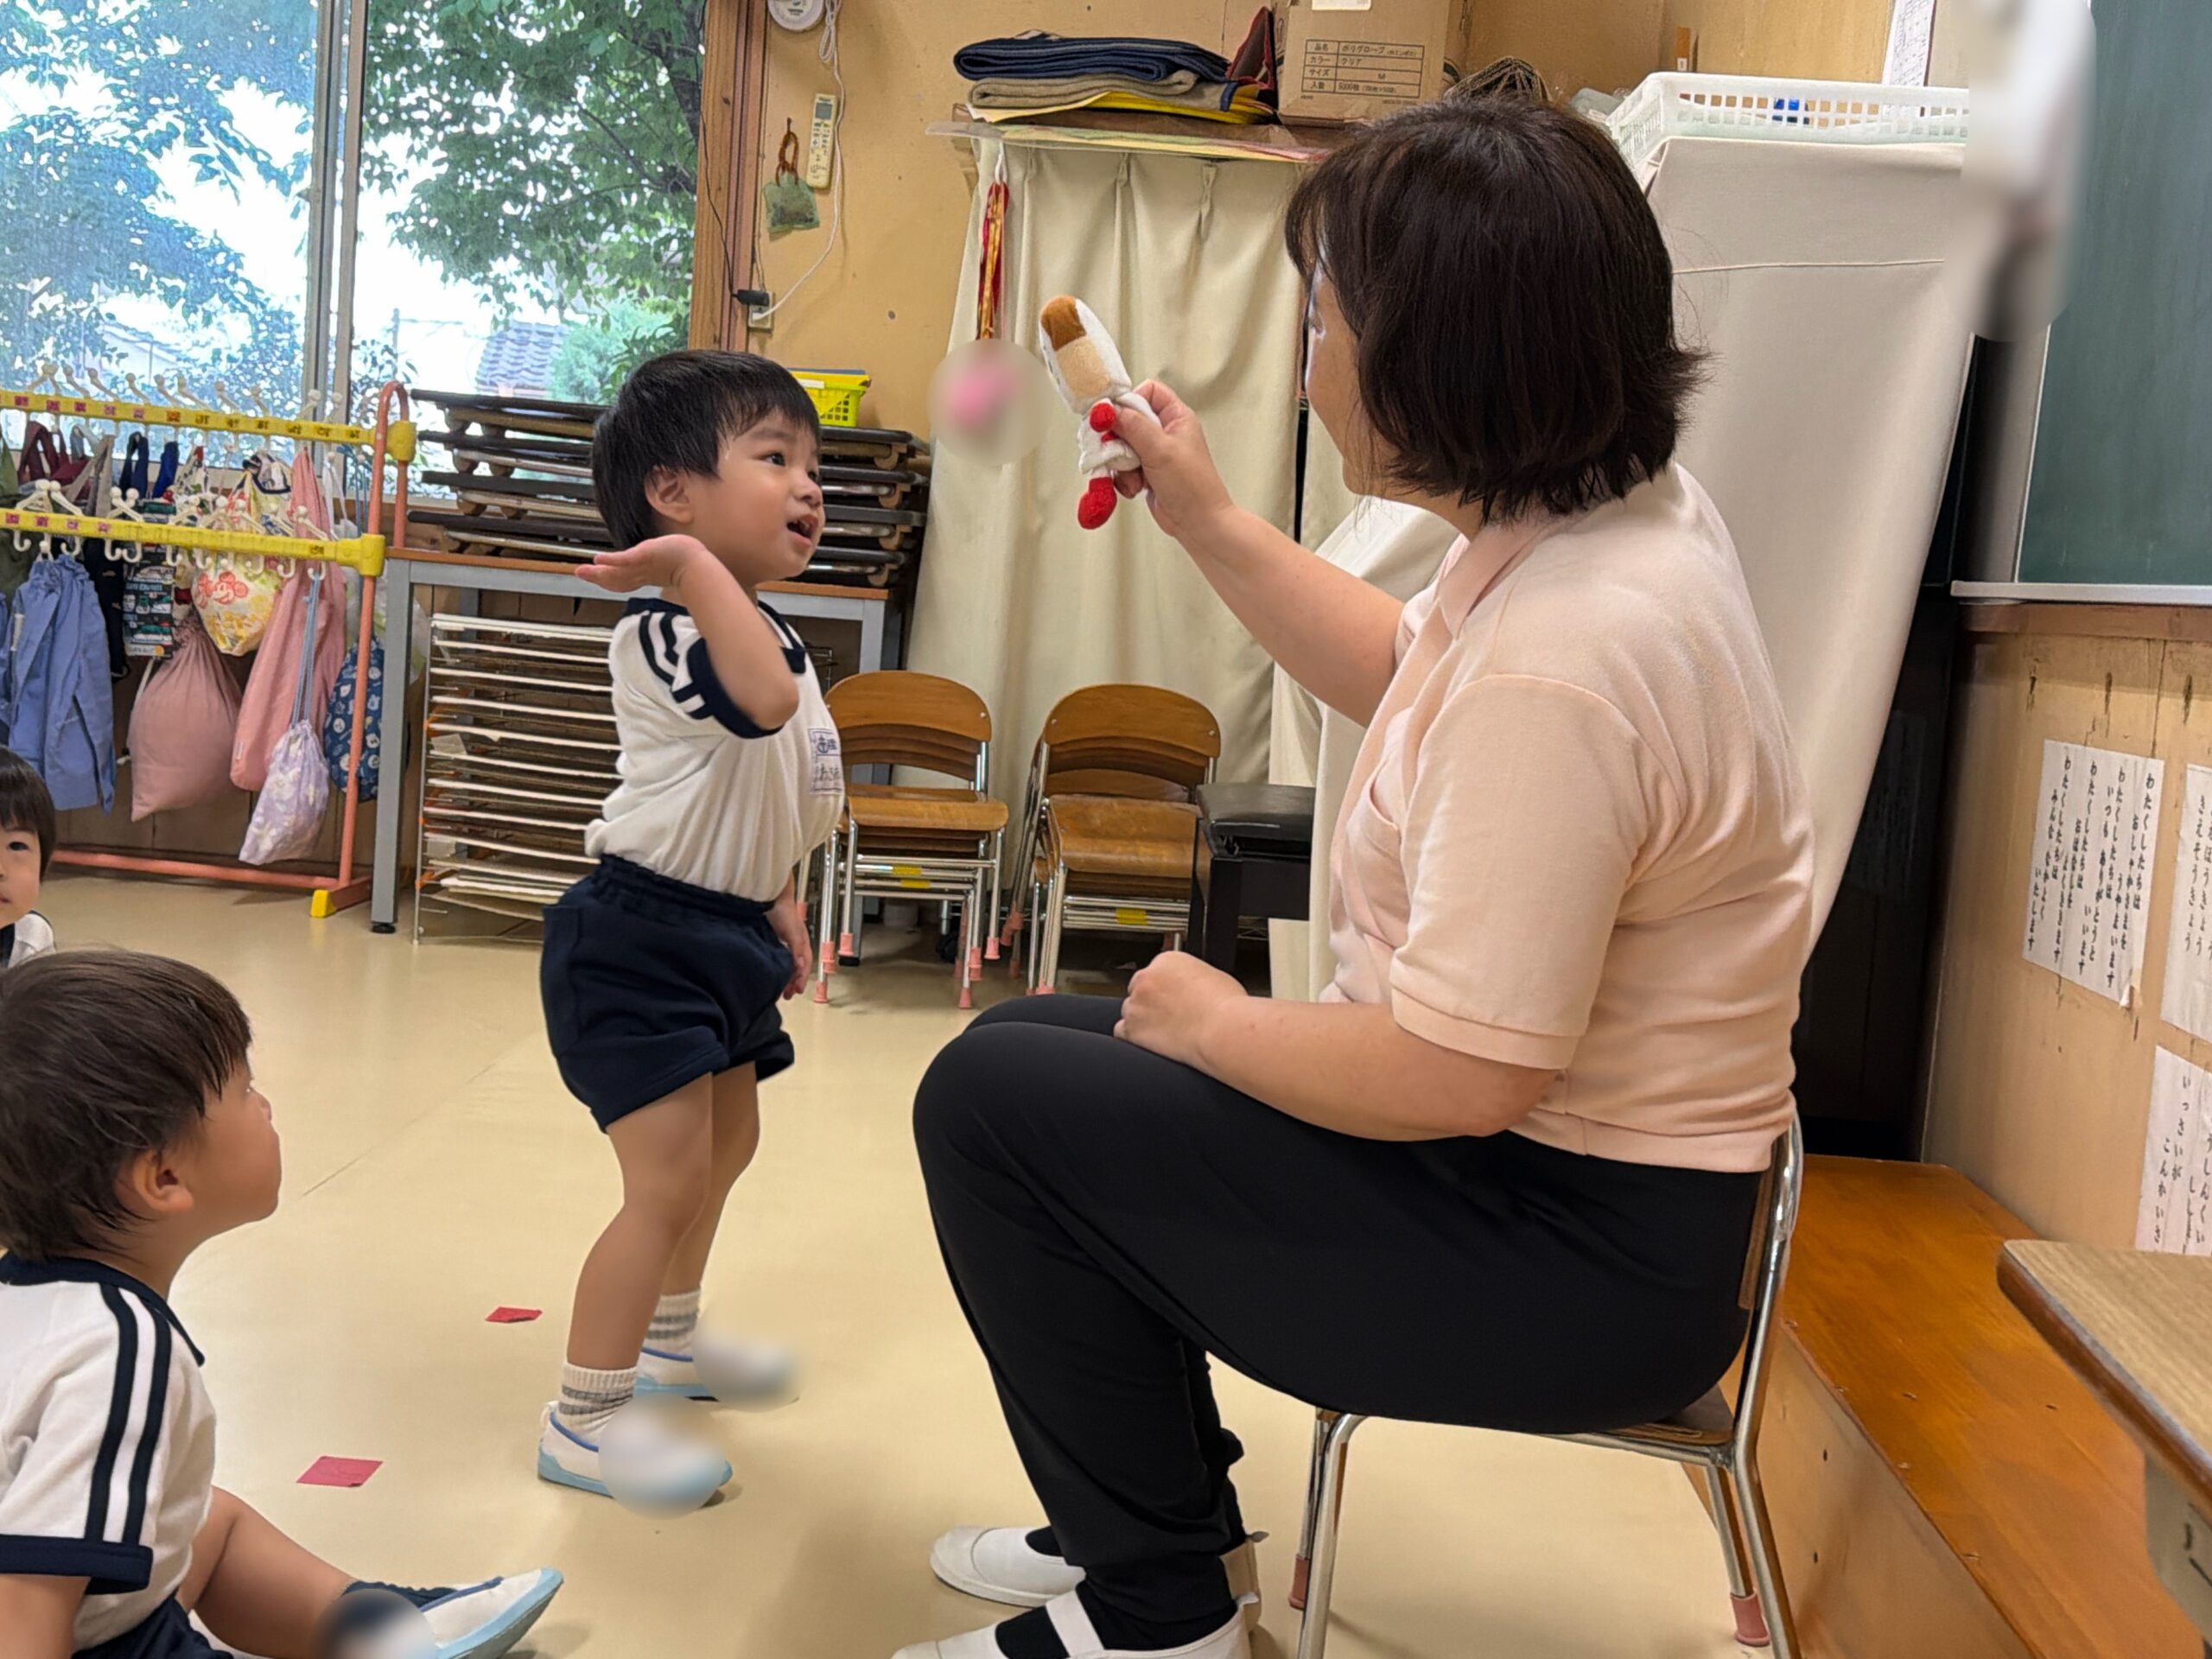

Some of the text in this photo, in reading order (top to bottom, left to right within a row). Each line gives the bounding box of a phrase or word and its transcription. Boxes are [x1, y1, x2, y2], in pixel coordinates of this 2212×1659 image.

[1308, 68, 1332, 77] サイズ
[1310, 54, 1332, 64] カラー
[1313, 43, 1329, 52] 品名
[1341, 44, 1386, 54] ポリグローブ
[2040, 789, 2058, 921] みんな なかよく
[2051, 756, 2071, 880] わたくしたちは
[2067, 818, 2082, 909] おはなしを
[2077, 760, 2098, 889] わたくしたちは
[2106, 767, 2126, 899] わたくしたちは
[2133, 772, 2155, 910] わたくしたちは
[2184, 795, 2206, 951] きえそうきょう
[2028, 867, 2042, 951] いたします
[2054, 854, 2069, 963] よくききます
[2089, 786, 2114, 962] いつも ありがとうと
[2121, 814, 2141, 950] おしゃかさまを
[2078, 905, 2091, 975] いいます
[2107, 874, 2124, 988] うやまいます
[2171, 1075, 2191, 1180] いっさいが
